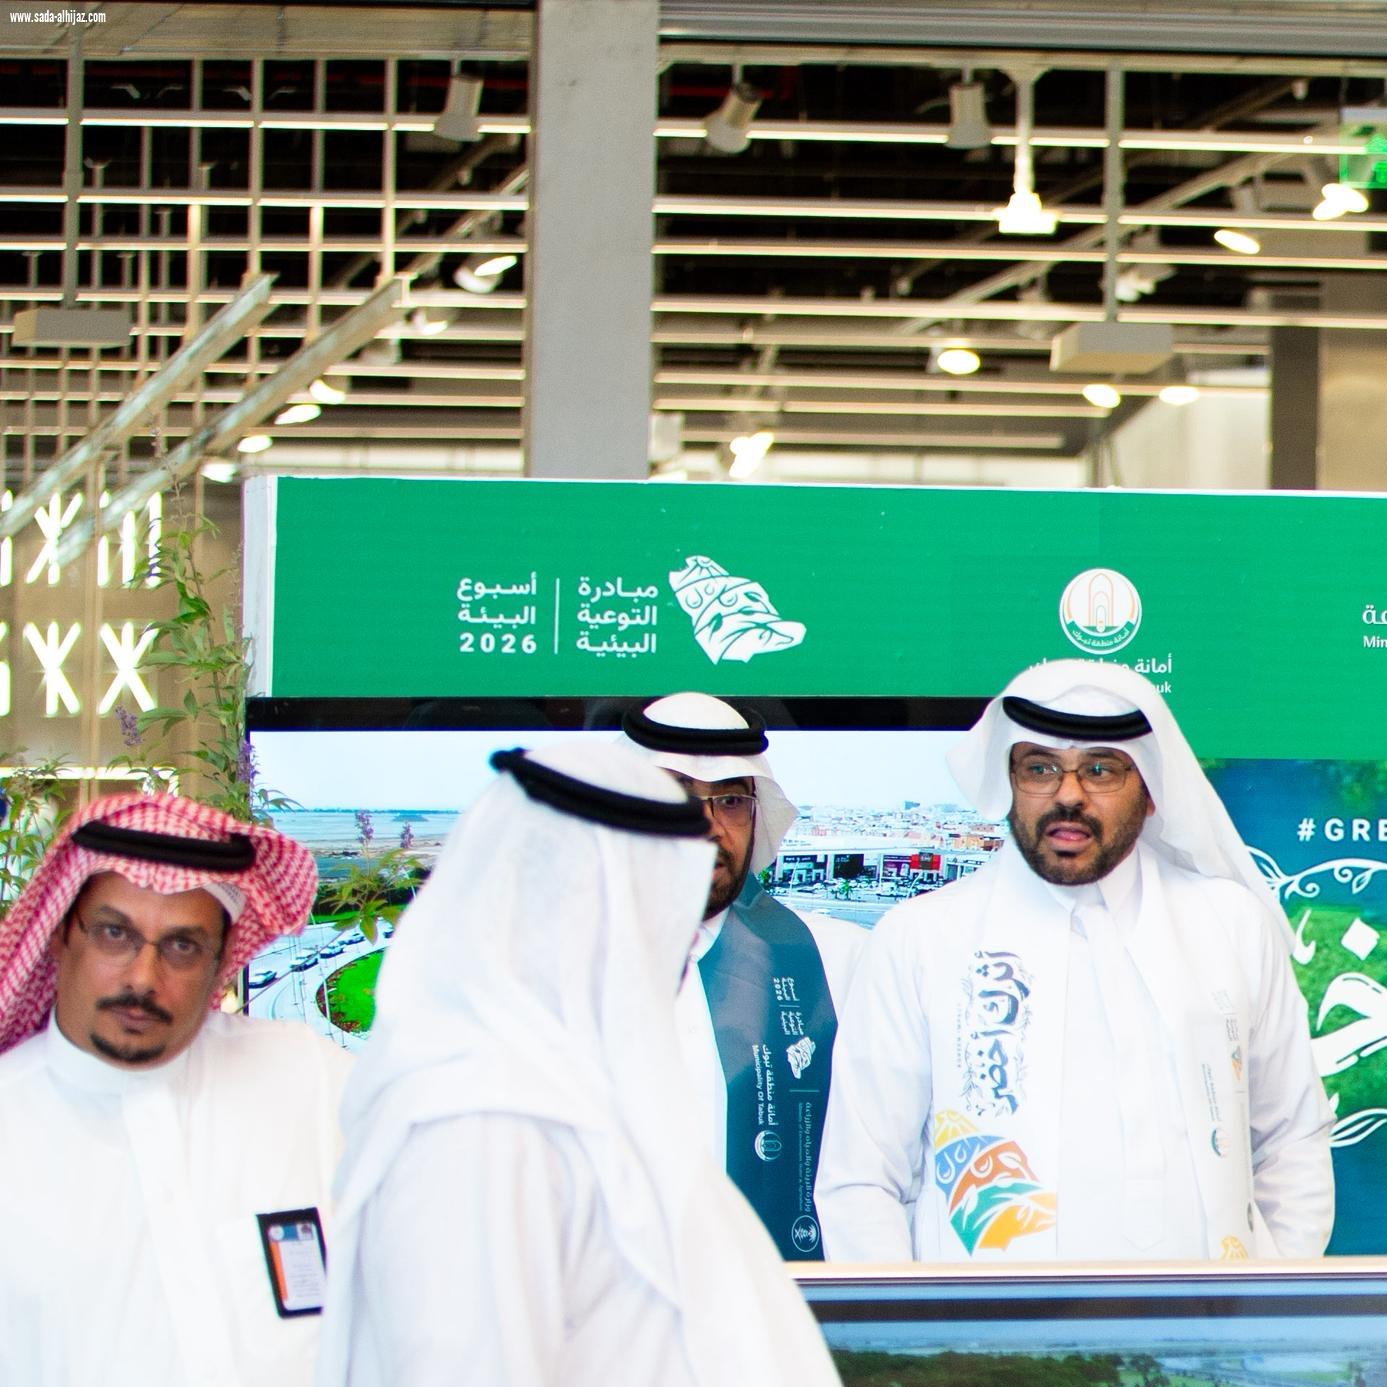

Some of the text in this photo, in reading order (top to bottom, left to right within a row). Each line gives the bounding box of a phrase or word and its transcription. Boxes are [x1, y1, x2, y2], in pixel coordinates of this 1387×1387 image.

[456, 572, 537, 599] أسبوع
[578, 576, 658, 603] مبادرة
[457, 603, 537, 628] البيئة
[576, 604, 657, 630] التوعية
[459, 633, 537, 654] 2026
[576, 632, 656, 657] البيئية
[1134, 653, 1172, 674] أمانة
[773, 978, 784, 1001] 2026
[752, 1044, 763, 1090] Municipality
